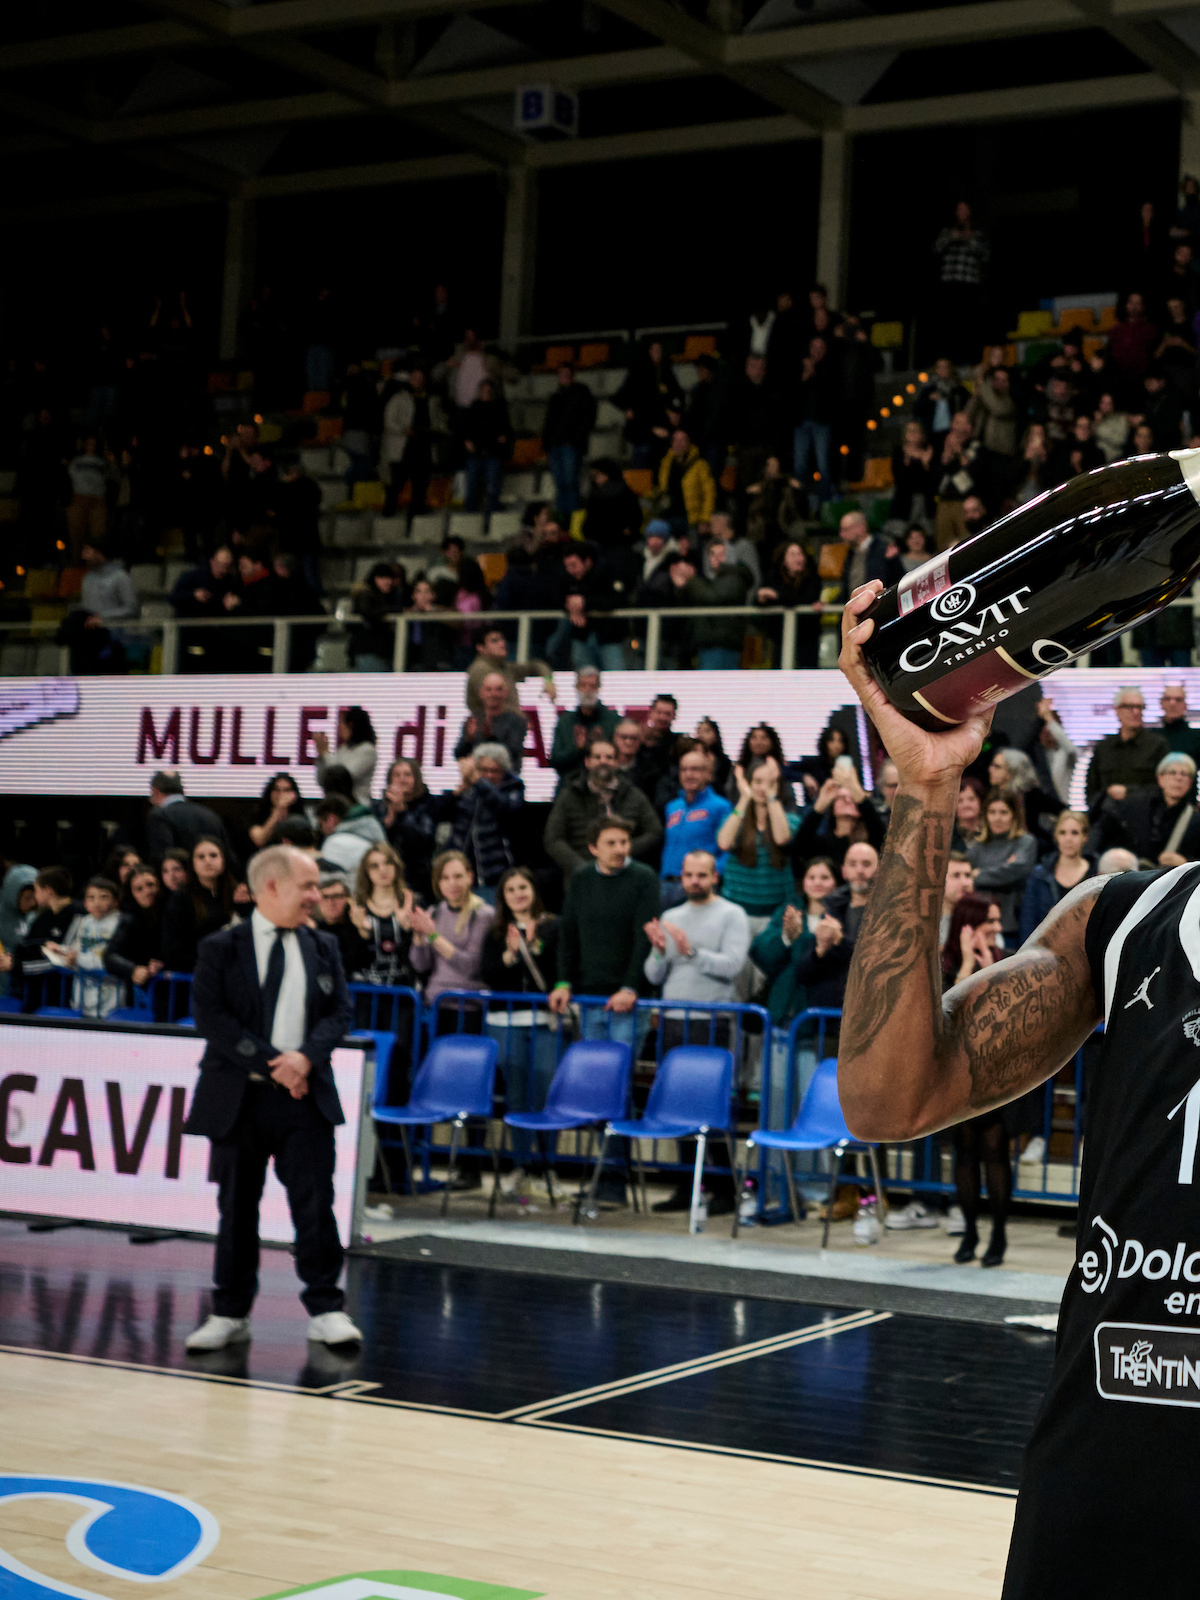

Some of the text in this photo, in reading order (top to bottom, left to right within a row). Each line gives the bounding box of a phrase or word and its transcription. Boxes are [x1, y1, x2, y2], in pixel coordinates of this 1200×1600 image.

[522, 90, 543, 120] B
[899, 585, 1032, 673] CAVIT
[943, 628, 1010, 666] TRENTO
[395, 705, 446, 768] di
[0, 1073, 220, 1183] CAVI
